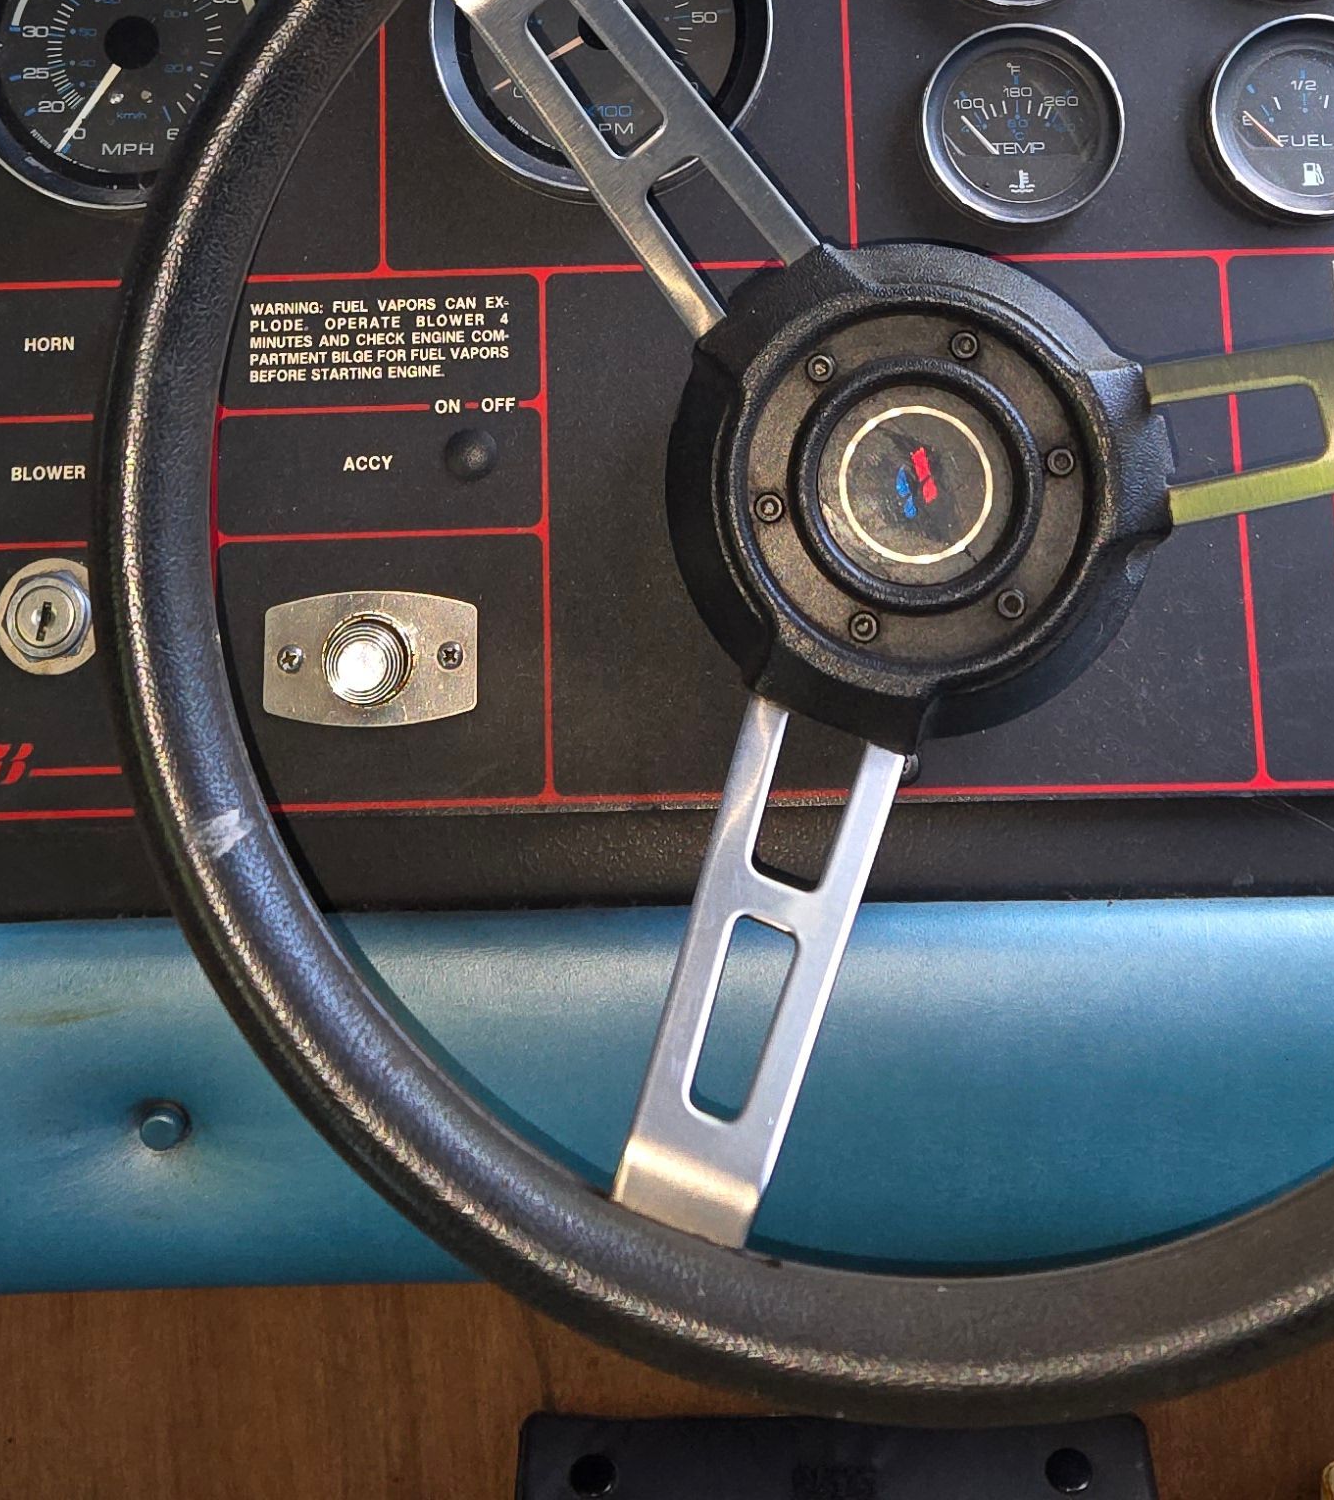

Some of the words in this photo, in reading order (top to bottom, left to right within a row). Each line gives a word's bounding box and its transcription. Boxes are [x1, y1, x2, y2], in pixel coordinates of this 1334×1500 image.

[691, 11, 717, 24] 50
[22, 25, 49, 38] 30
[22, 67, 49, 80] 25
[1003, 87, 1032, 98] 180
[1290, 80, 1317, 91] 1/2
[38, 100, 65, 113] 20
[953, 98, 985, 110] 100
[1043, 96, 1079, 107] 260
[598, 122, 634, 136] PM
[1276, 134, 1334, 148] FUEL
[101, 143, 155, 156] MPH
[992, 142, 1045, 155] TEMP
[250, 301, 324, 316] WARNING:
[332, 299, 368, 314] FUEL
[378, 297, 437, 312] VAPORS
[445, 296, 476, 310] CAN
[485, 295, 509, 309] EX-
[250, 318, 309, 332] PLODE.
[324, 316, 401, 330] OPERATE
[416, 313, 485, 328] BLOWER
[499, 312, 509, 325] 4
[23, 336, 75, 352] HORN
[250, 334, 313, 349] MINUTES
[319, 333, 350, 347] AND
[355, 331, 405, 346] CHECK
[411, 330, 465, 345] ENGINE
[471, 329, 510, 343] COM-
[250, 351, 329, 366] PARTMENT
[331, 349, 373, 364] BILGE
[377, 348, 407, 363] FOR
[410, 347, 446, 362] FUEL
[450, 345, 509, 360] VAPORS
[249, 368, 307, 383] BEFORE
[311, 366, 383, 381] STARTING
[387, 364, 445, 379] ENGINE.
[434, 399, 461, 414] ON
[481, 397, 516, 413] OFF
[343, 455, 393, 472] ACCY
[10, 464, 87, 483] BLOWER
